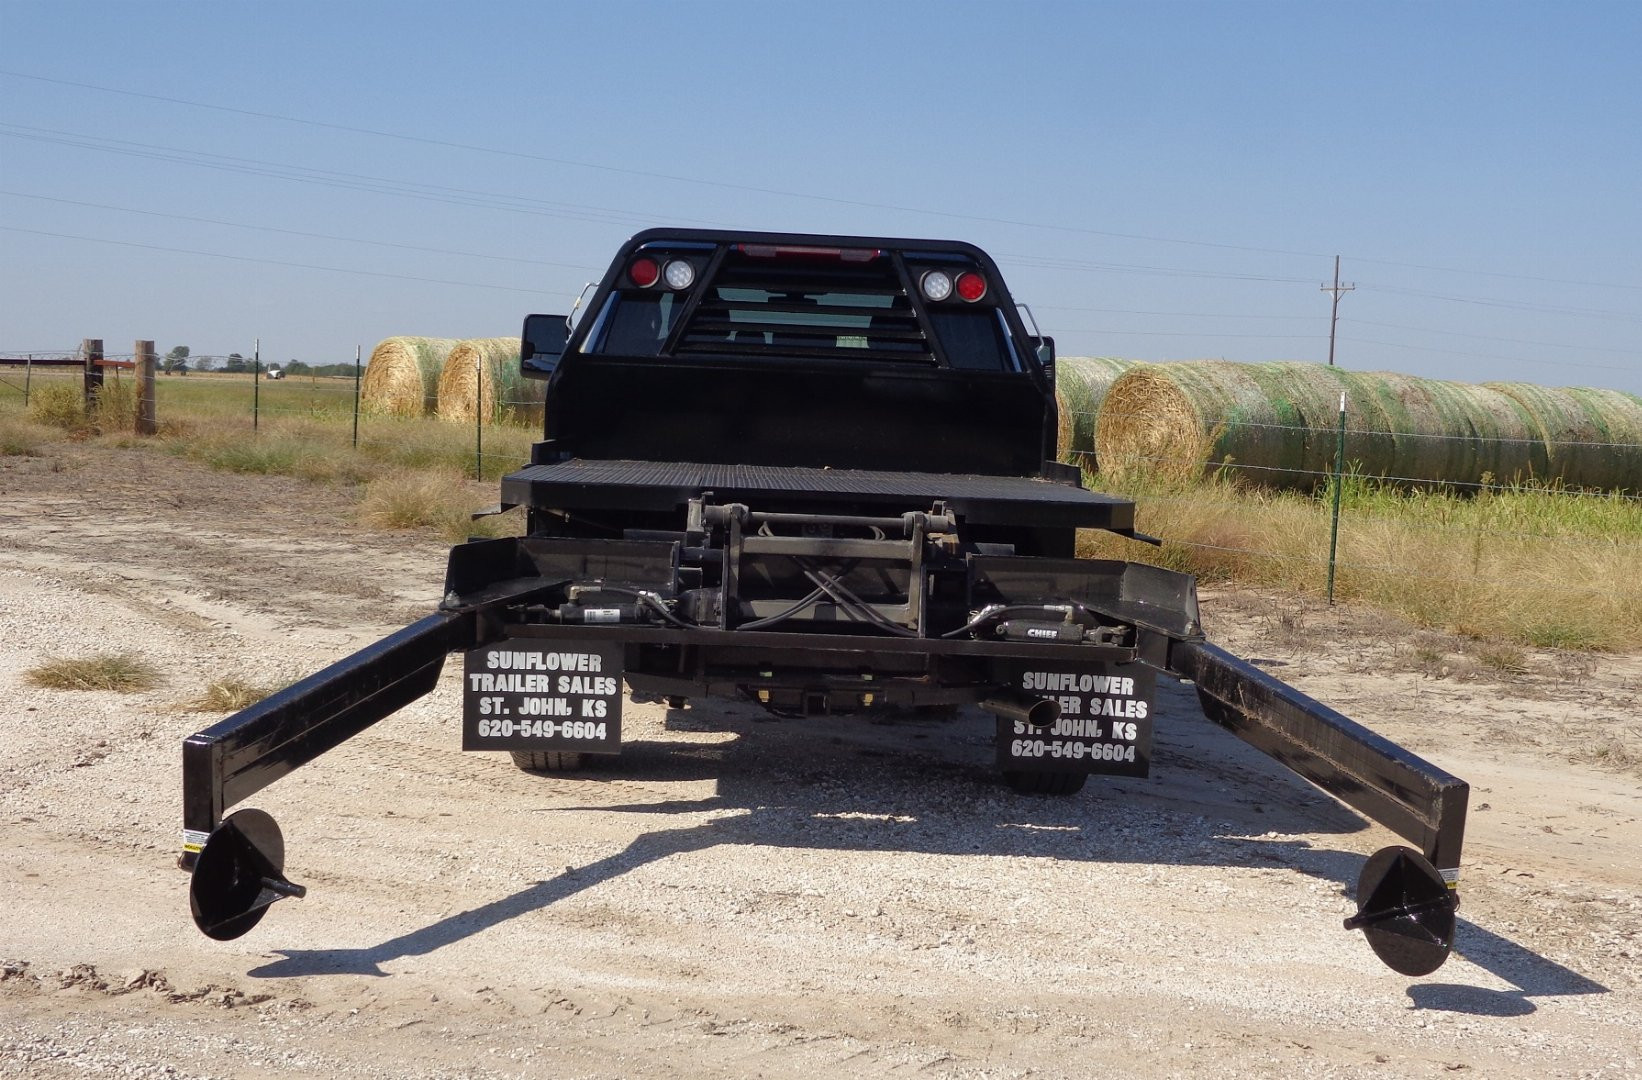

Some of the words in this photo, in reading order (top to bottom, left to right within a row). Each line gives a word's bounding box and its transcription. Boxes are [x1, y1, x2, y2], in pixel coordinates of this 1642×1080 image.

[1027, 628, 1058, 639] CHIEF
[487, 650, 602, 672] SUNFLOWER
[469, 673, 550, 693] TRAILER
[558, 675, 617, 696] SALES
[1022, 671, 1134, 696] SUNFLOWER
[479, 696, 510, 715] ST.
[518, 697, 573, 716] JOHN,
[581, 699, 607, 718] KS
[1089, 697, 1148, 719] SALES
[478, 718, 607, 740] 620-549-6604
[1050, 718, 1103, 738] JOHN,
[1111, 721, 1138, 741] KS
[1011, 739, 1136, 763] 620-549-6604
